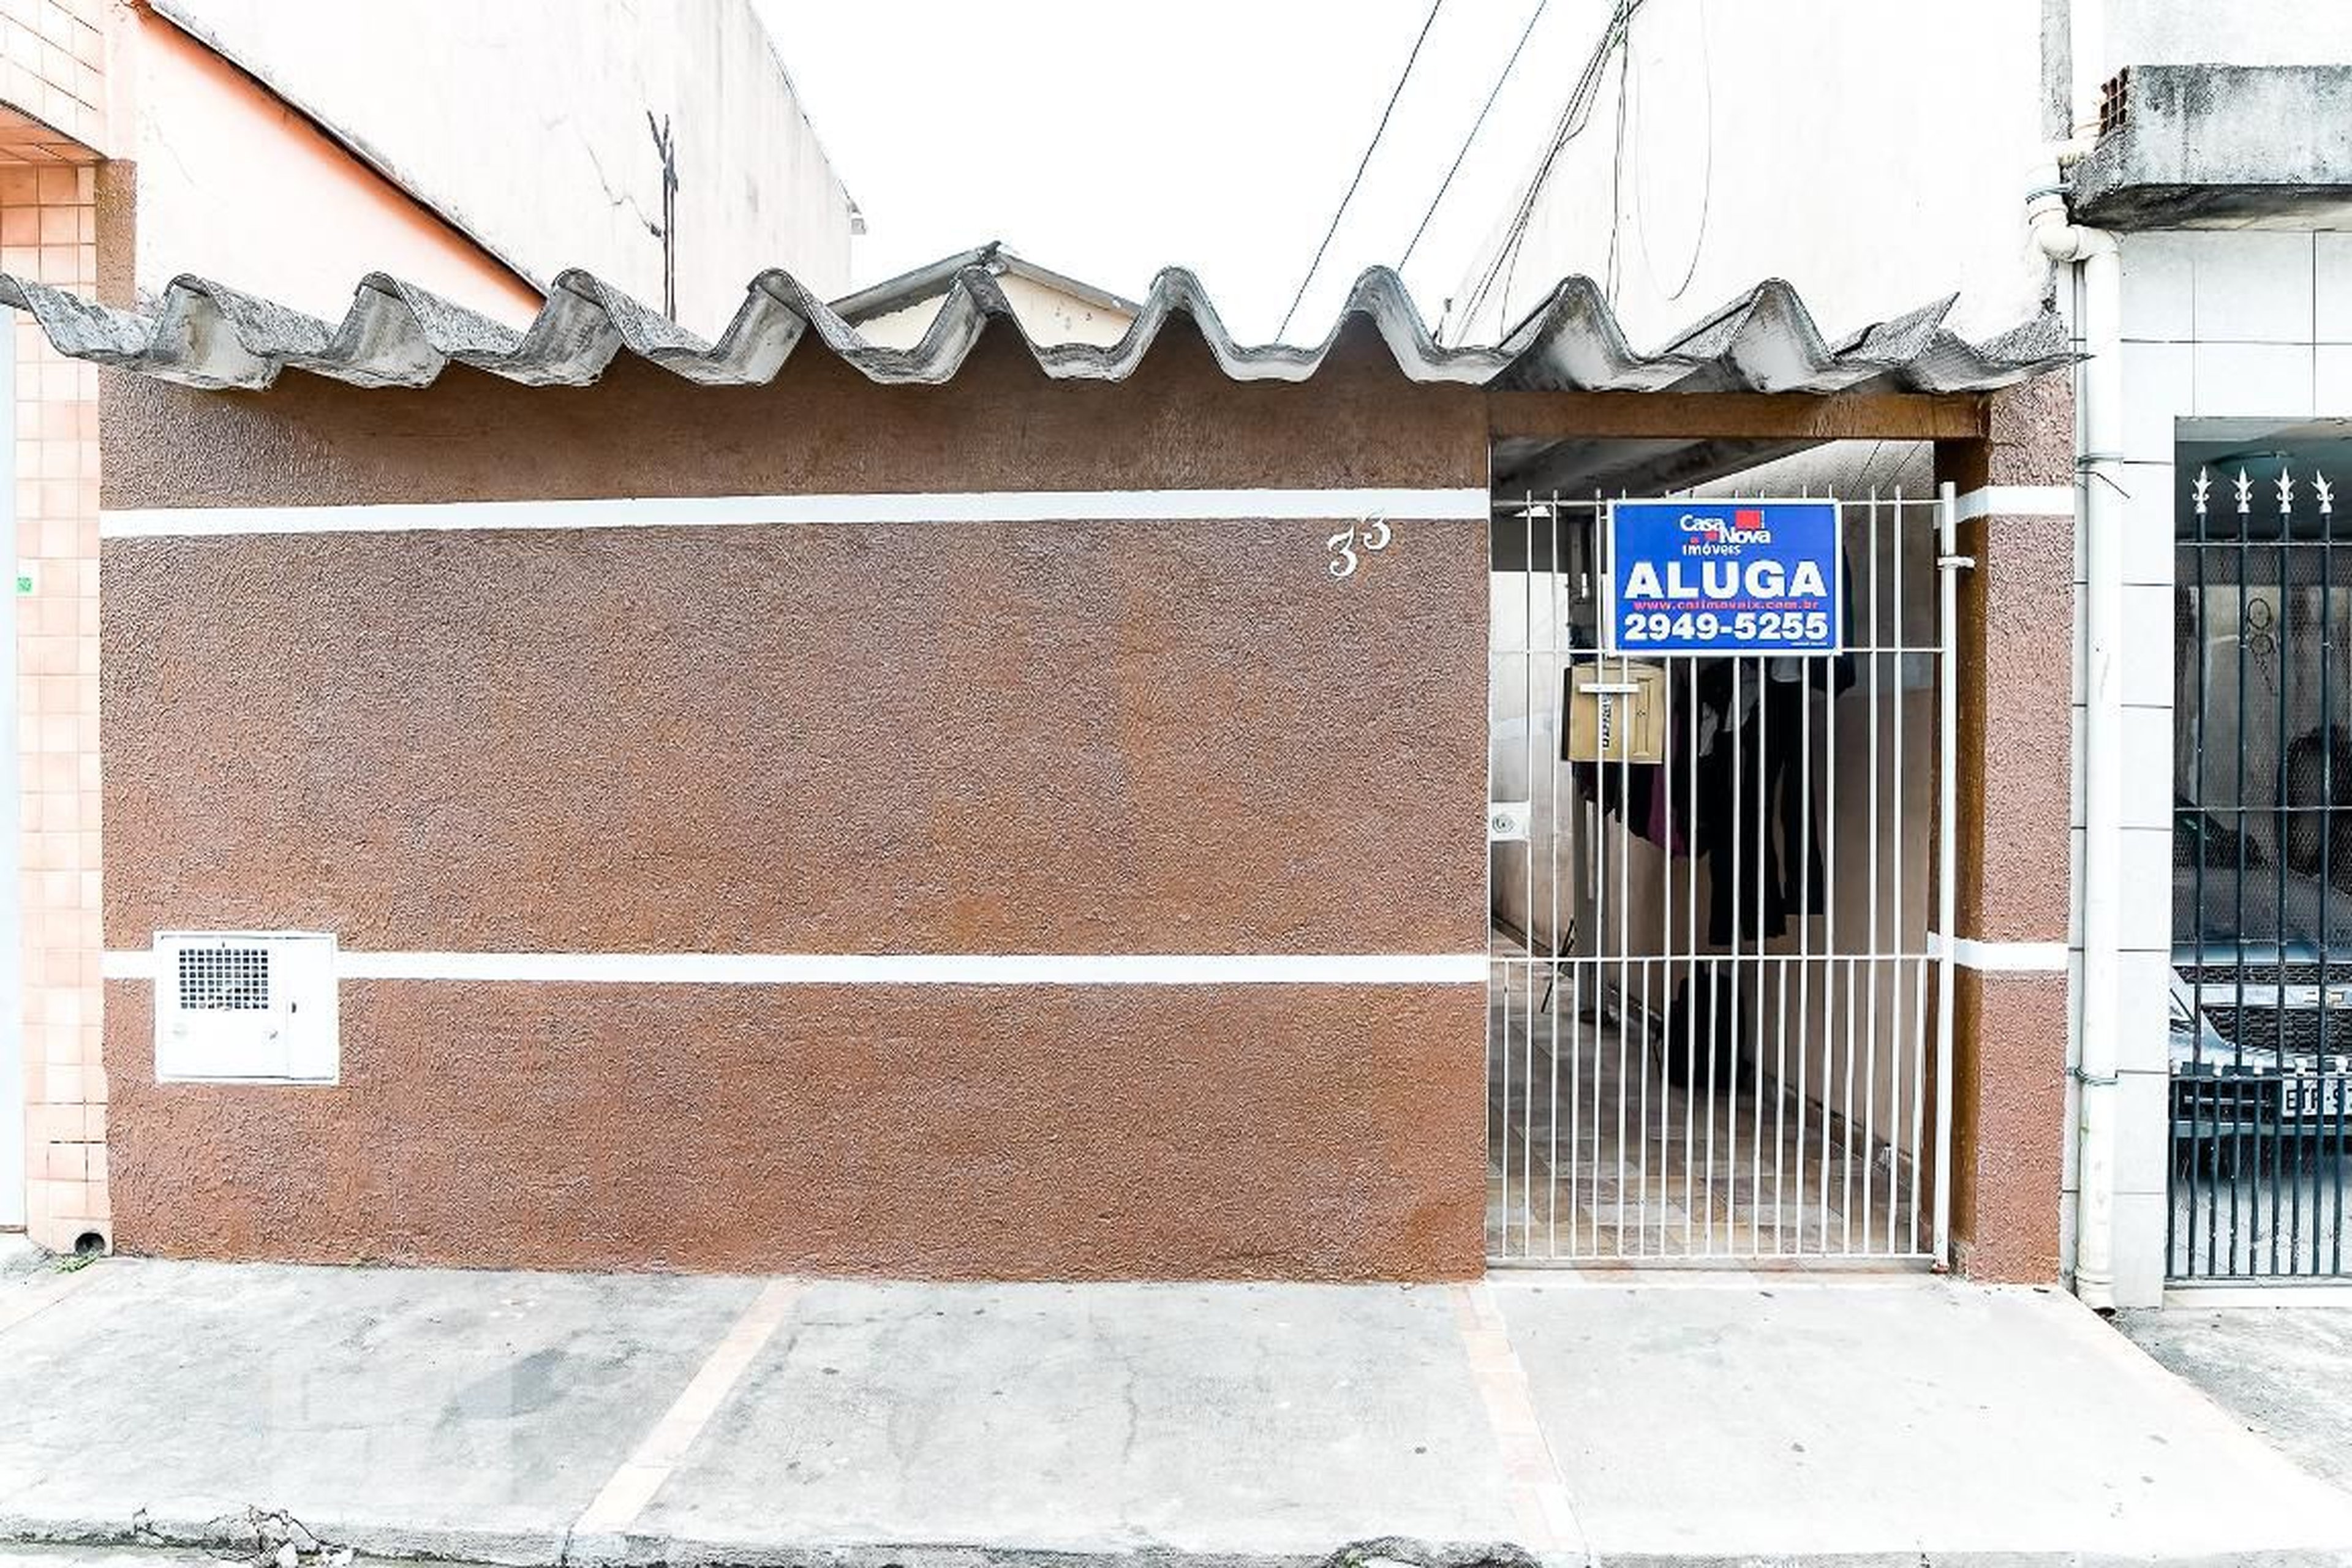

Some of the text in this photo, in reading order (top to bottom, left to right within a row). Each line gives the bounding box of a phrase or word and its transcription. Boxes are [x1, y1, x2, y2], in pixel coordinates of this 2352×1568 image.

[1680, 514, 1725, 532] Casa
[1719, 526, 1771, 544] Nova
[1328, 514, 1390, 576] 33
[1624, 560, 1827, 599] ALUGA
[1624, 612, 1828, 641] 2949-5255
